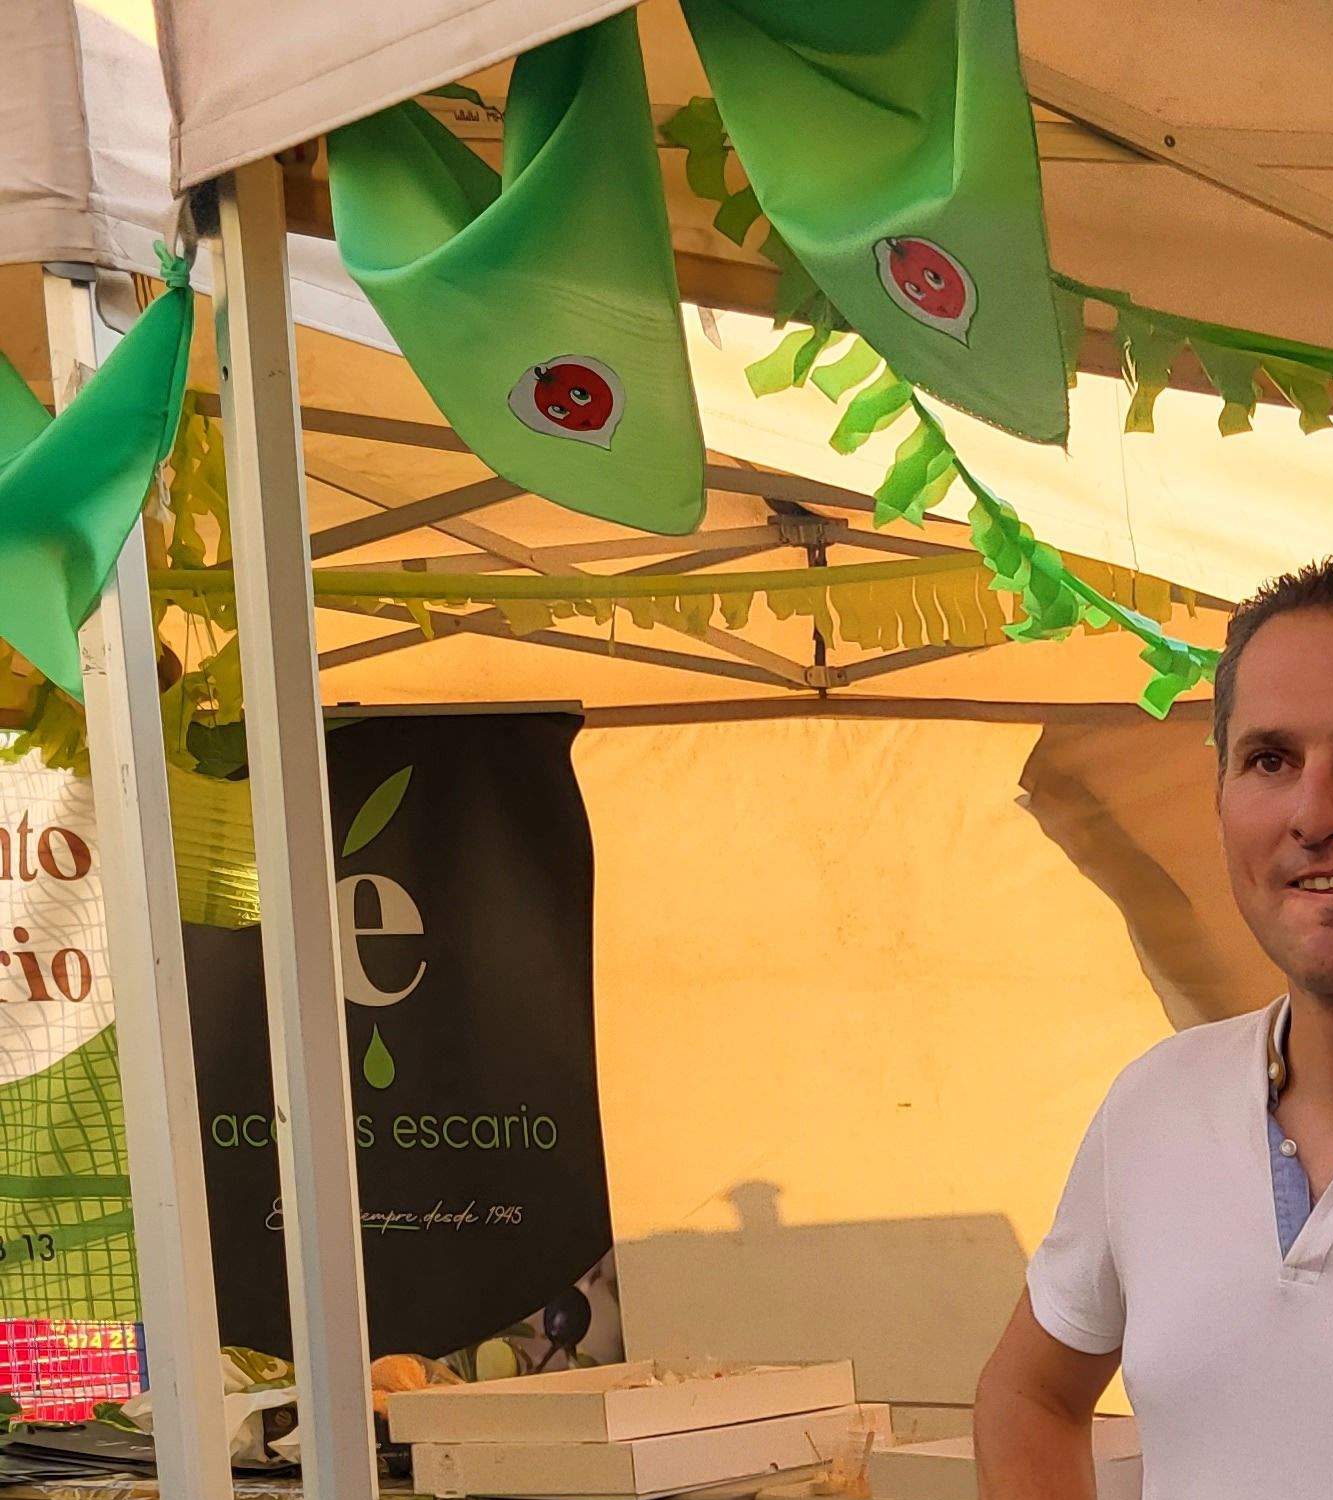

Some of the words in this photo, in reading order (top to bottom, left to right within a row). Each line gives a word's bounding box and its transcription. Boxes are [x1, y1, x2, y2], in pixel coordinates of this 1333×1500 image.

[0, 926, 92, 1003] io
[393, 1104, 558, 1149] escario
[423, 1200, 480, 1232] desde
[485, 1205, 523, 1226] 1945
[22, 1233, 55, 1262] 13
